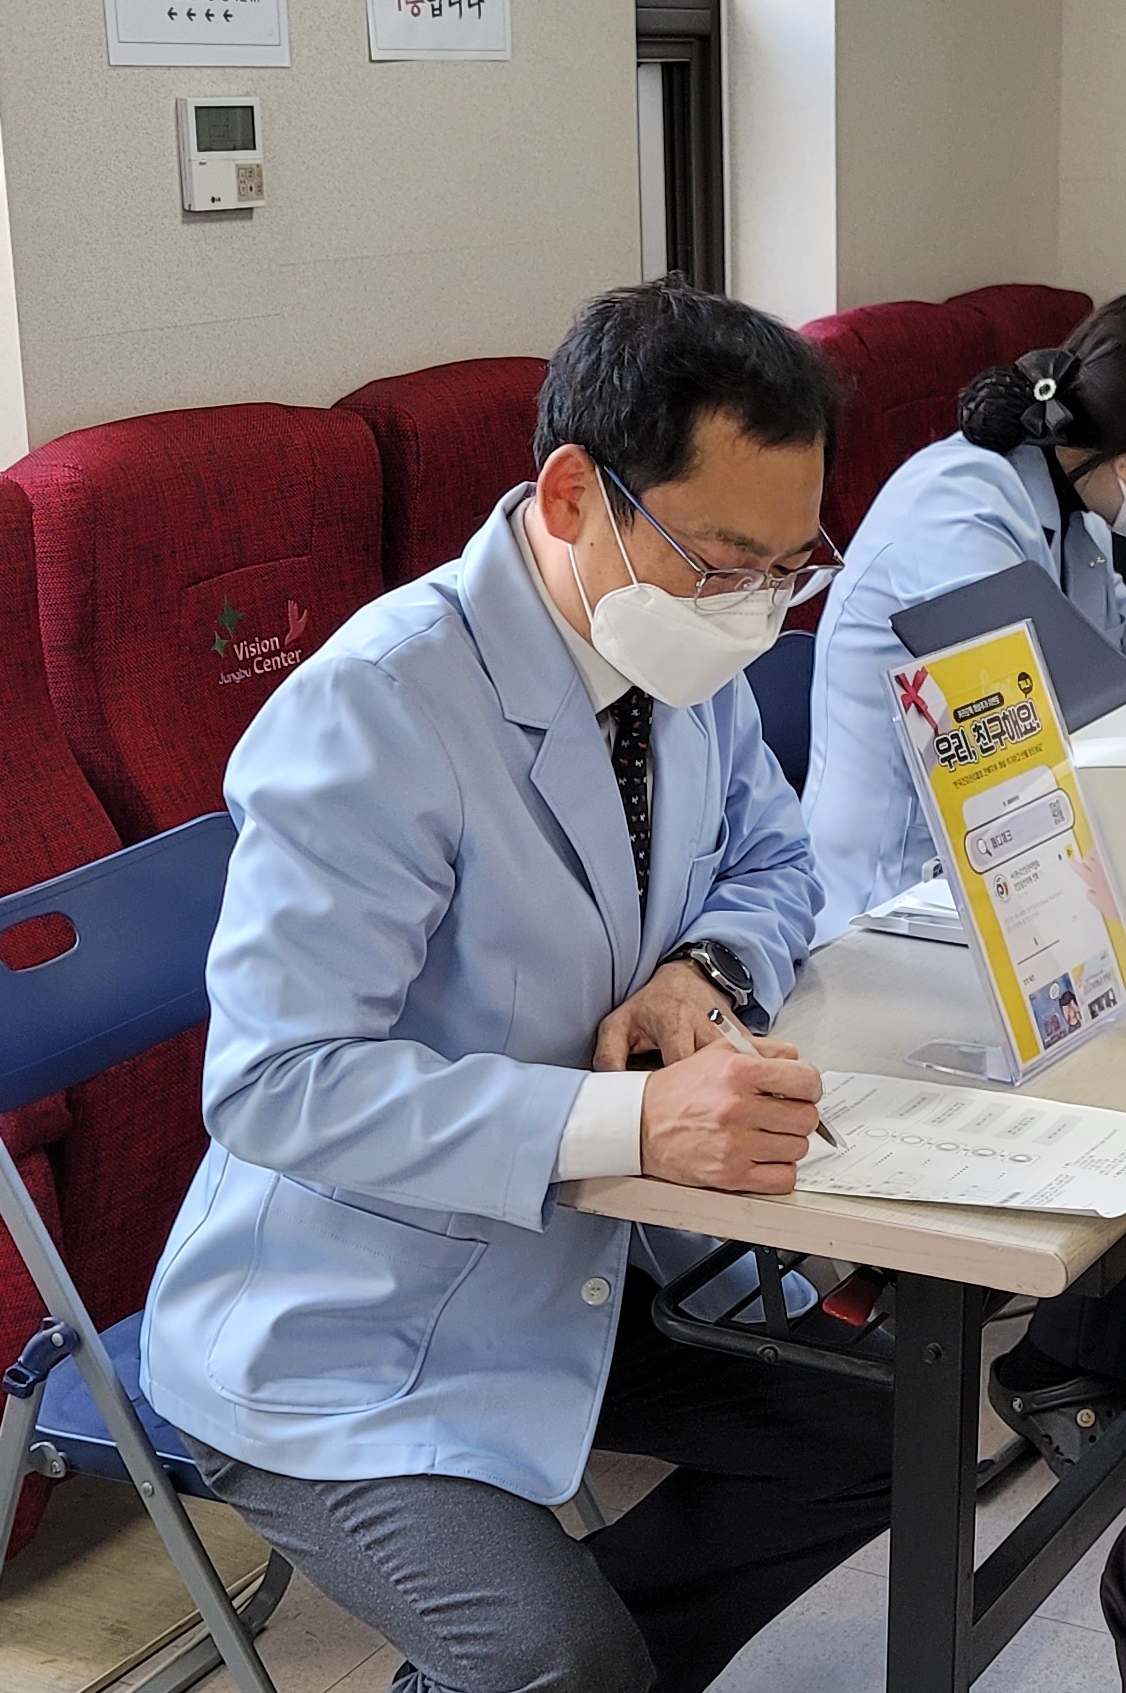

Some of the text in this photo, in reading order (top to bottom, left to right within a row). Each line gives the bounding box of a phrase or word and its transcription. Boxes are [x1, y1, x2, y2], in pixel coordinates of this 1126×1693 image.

[233, 636, 280, 661] Vision
[253, 649, 302, 674] Center
[935, 727, 979, 771] 우리,
[971, 700, 1041, 756] 친구해요!
